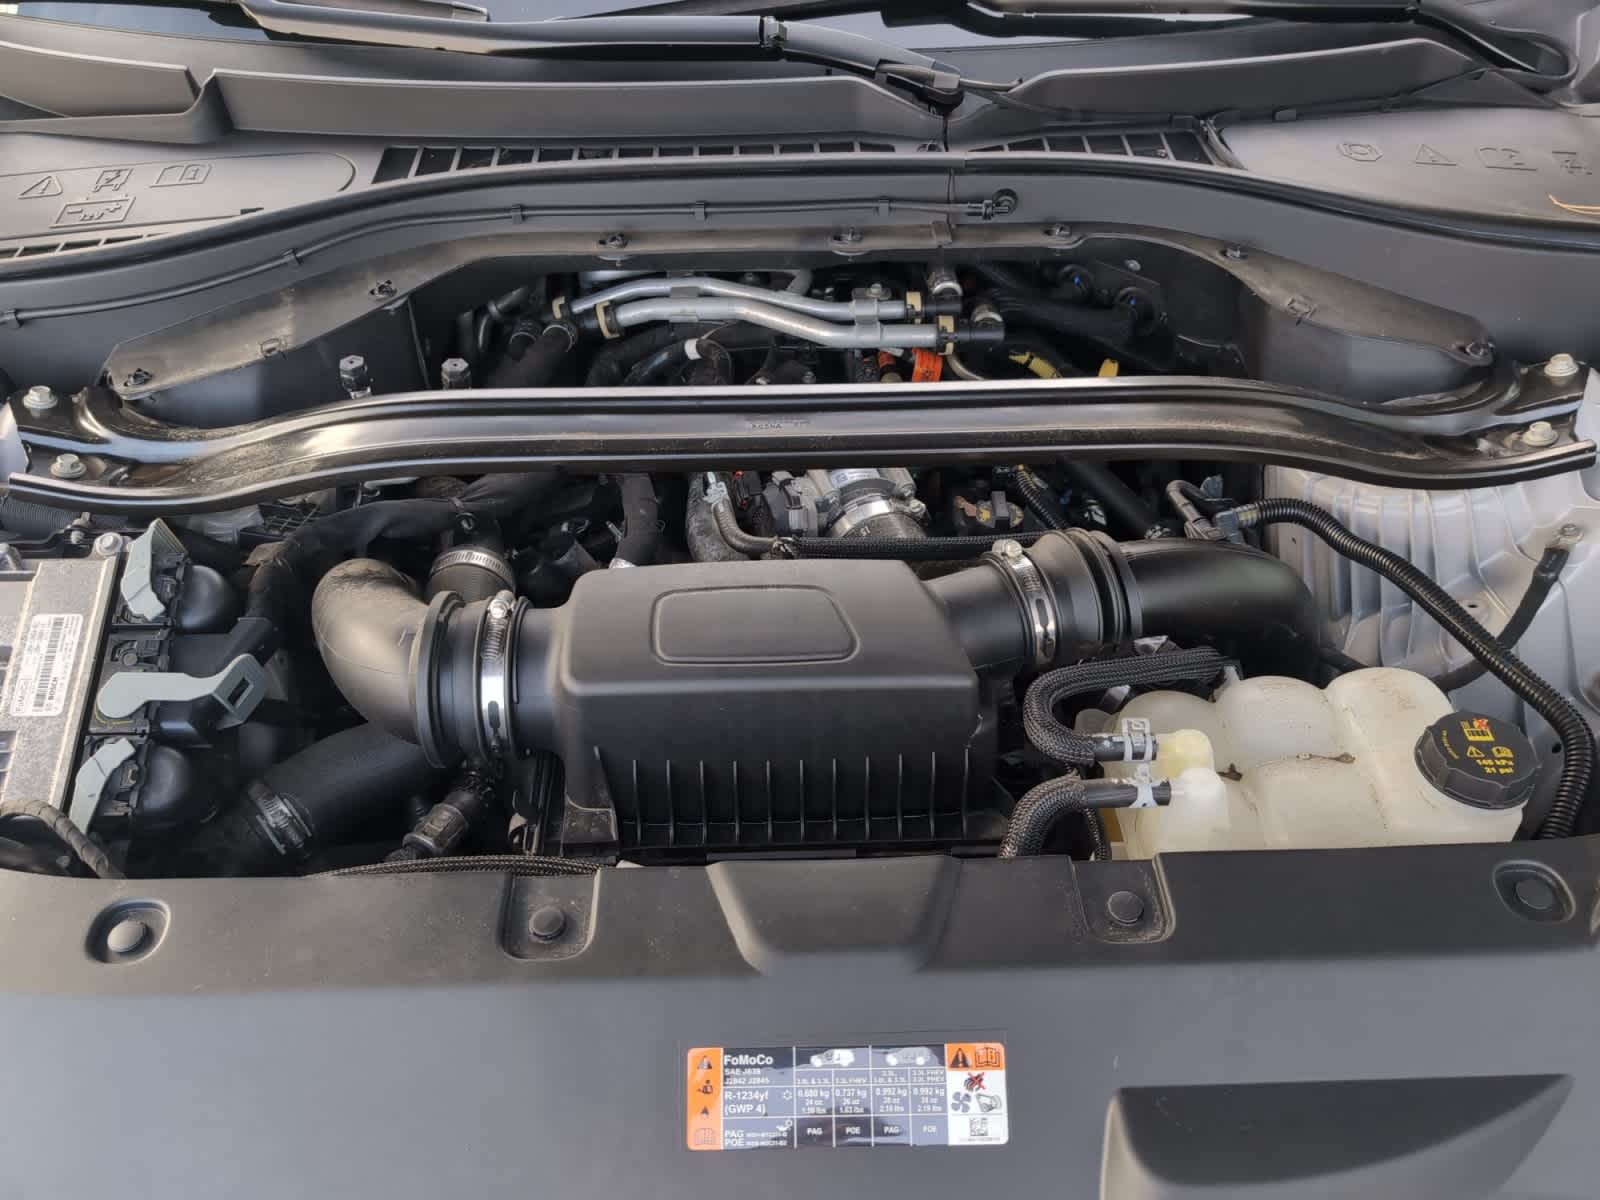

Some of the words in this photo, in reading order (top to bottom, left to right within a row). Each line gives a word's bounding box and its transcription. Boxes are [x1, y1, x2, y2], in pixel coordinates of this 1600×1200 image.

[47, 677, 58, 701] BOSCH
[724, 1054, 773, 1065] FoMoCo
[724, 1089, 769, 1102] R-1234yf
[820, 1088, 831, 1099] kg
[857, 1088, 868, 1099] kg
[897, 1087, 908, 1097] kg
[935, 1087, 945, 1097] kg
[724, 1103, 754, 1116] (GWP
[755, 1103, 766, 1116] 4)
[724, 1129, 745, 1138] PAG
[807, 1127, 823, 1136] PAG
[845, 1126, 861, 1135] POE
[883, 1125, 900, 1134] PAG
[724, 1138, 745, 1147] POE
